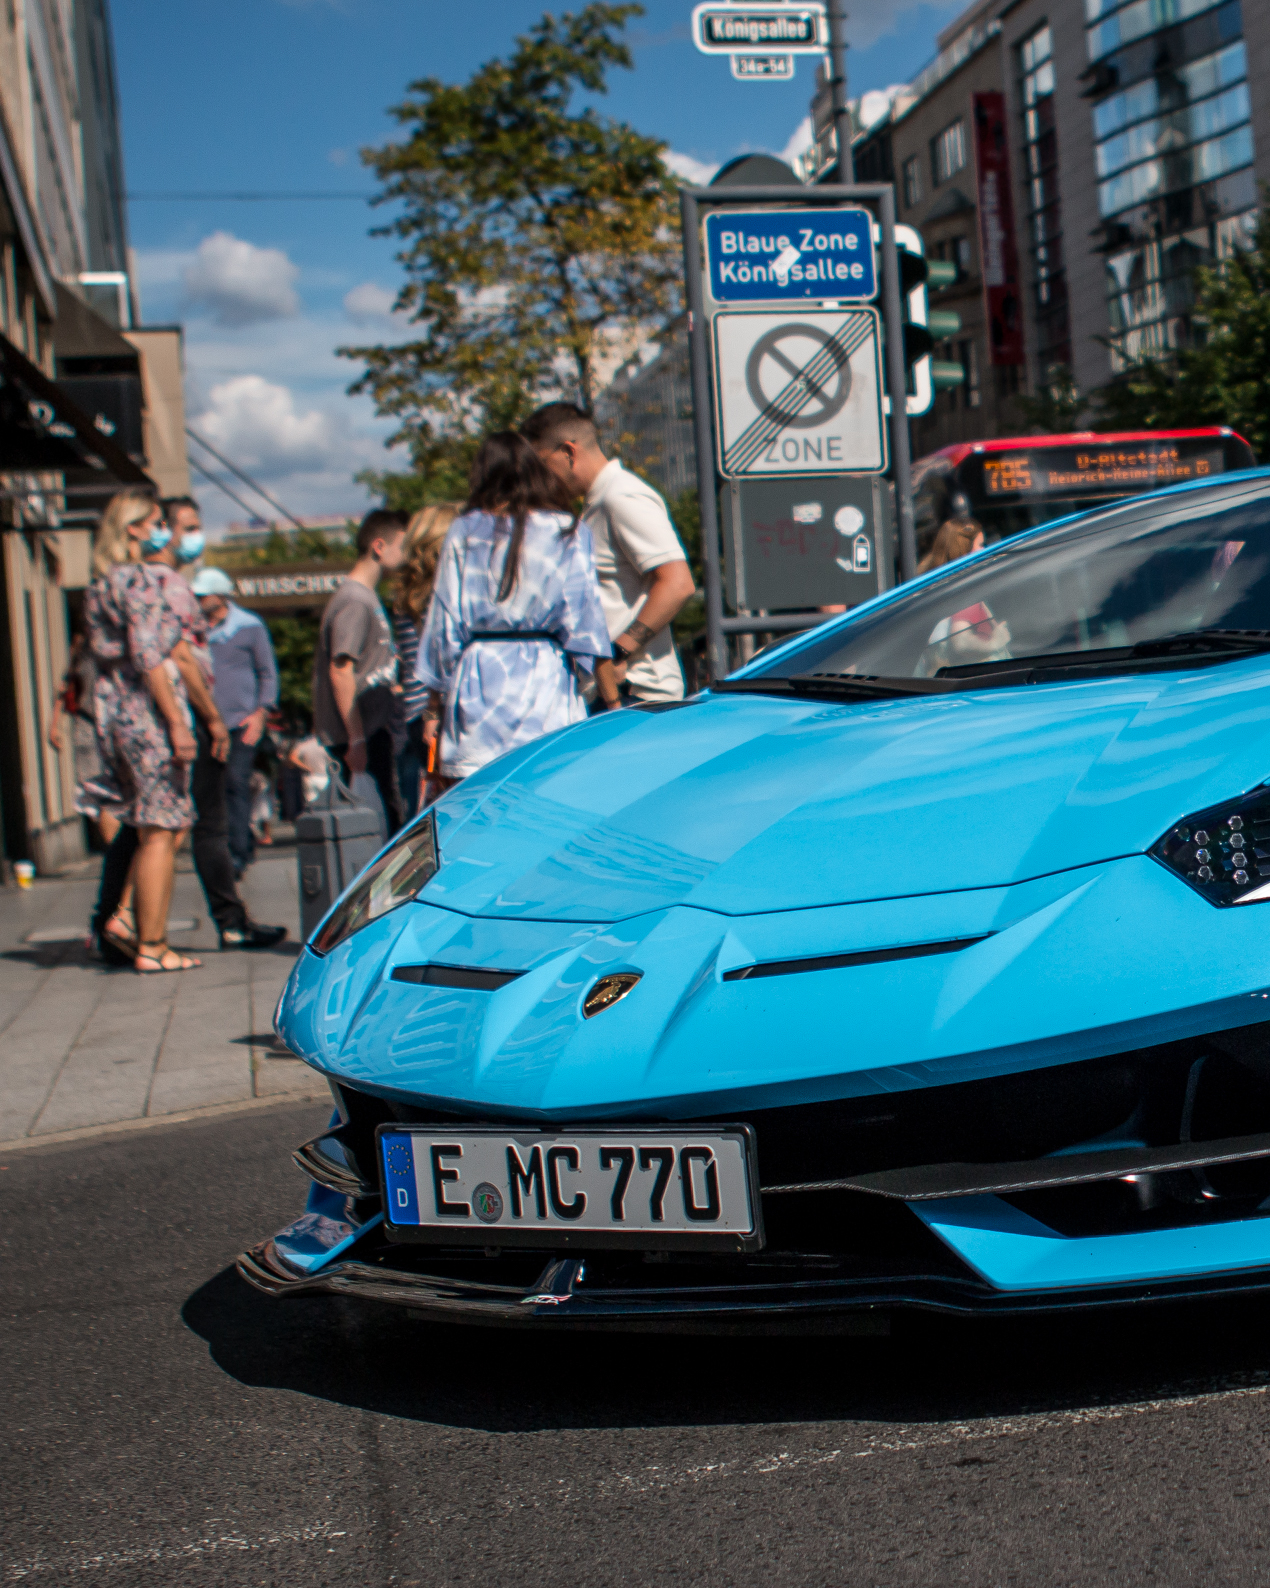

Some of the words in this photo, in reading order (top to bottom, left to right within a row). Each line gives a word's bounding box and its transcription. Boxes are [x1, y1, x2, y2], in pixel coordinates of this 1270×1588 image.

[712, 17, 807, 42] Königsallee
[740, 58, 786, 73] 34a-54
[720, 231, 791, 254] Blaue
[799, 229, 858, 251] Zone
[763, 436, 843, 463] ZONE
[984, 459, 1032, 491] 785
[397, 1188, 408, 1207] D
[431, 1144, 471, 1217] E
[507, 1144, 588, 1220] MC
[600, 1144, 721, 1222] 770
